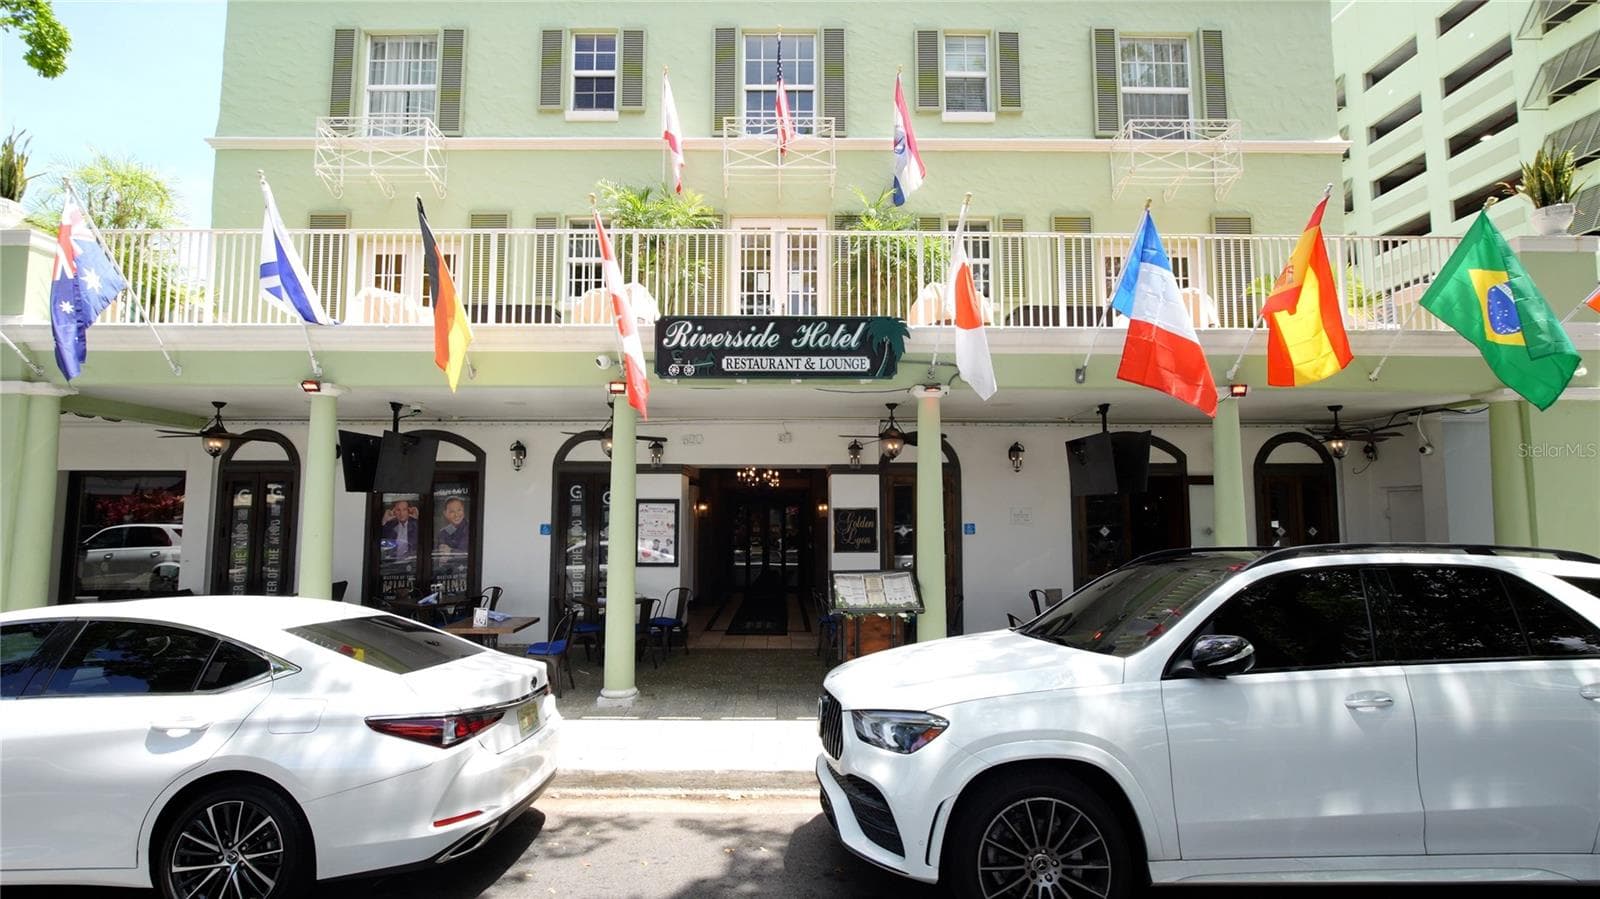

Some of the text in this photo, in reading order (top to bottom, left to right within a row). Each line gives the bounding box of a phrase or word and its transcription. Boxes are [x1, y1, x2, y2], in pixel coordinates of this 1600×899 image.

[663, 321, 868, 348] Riverside Hotel
[725, 358, 868, 371] RESTAURANT & LOUNGE
[837, 512, 874, 534] Golden
